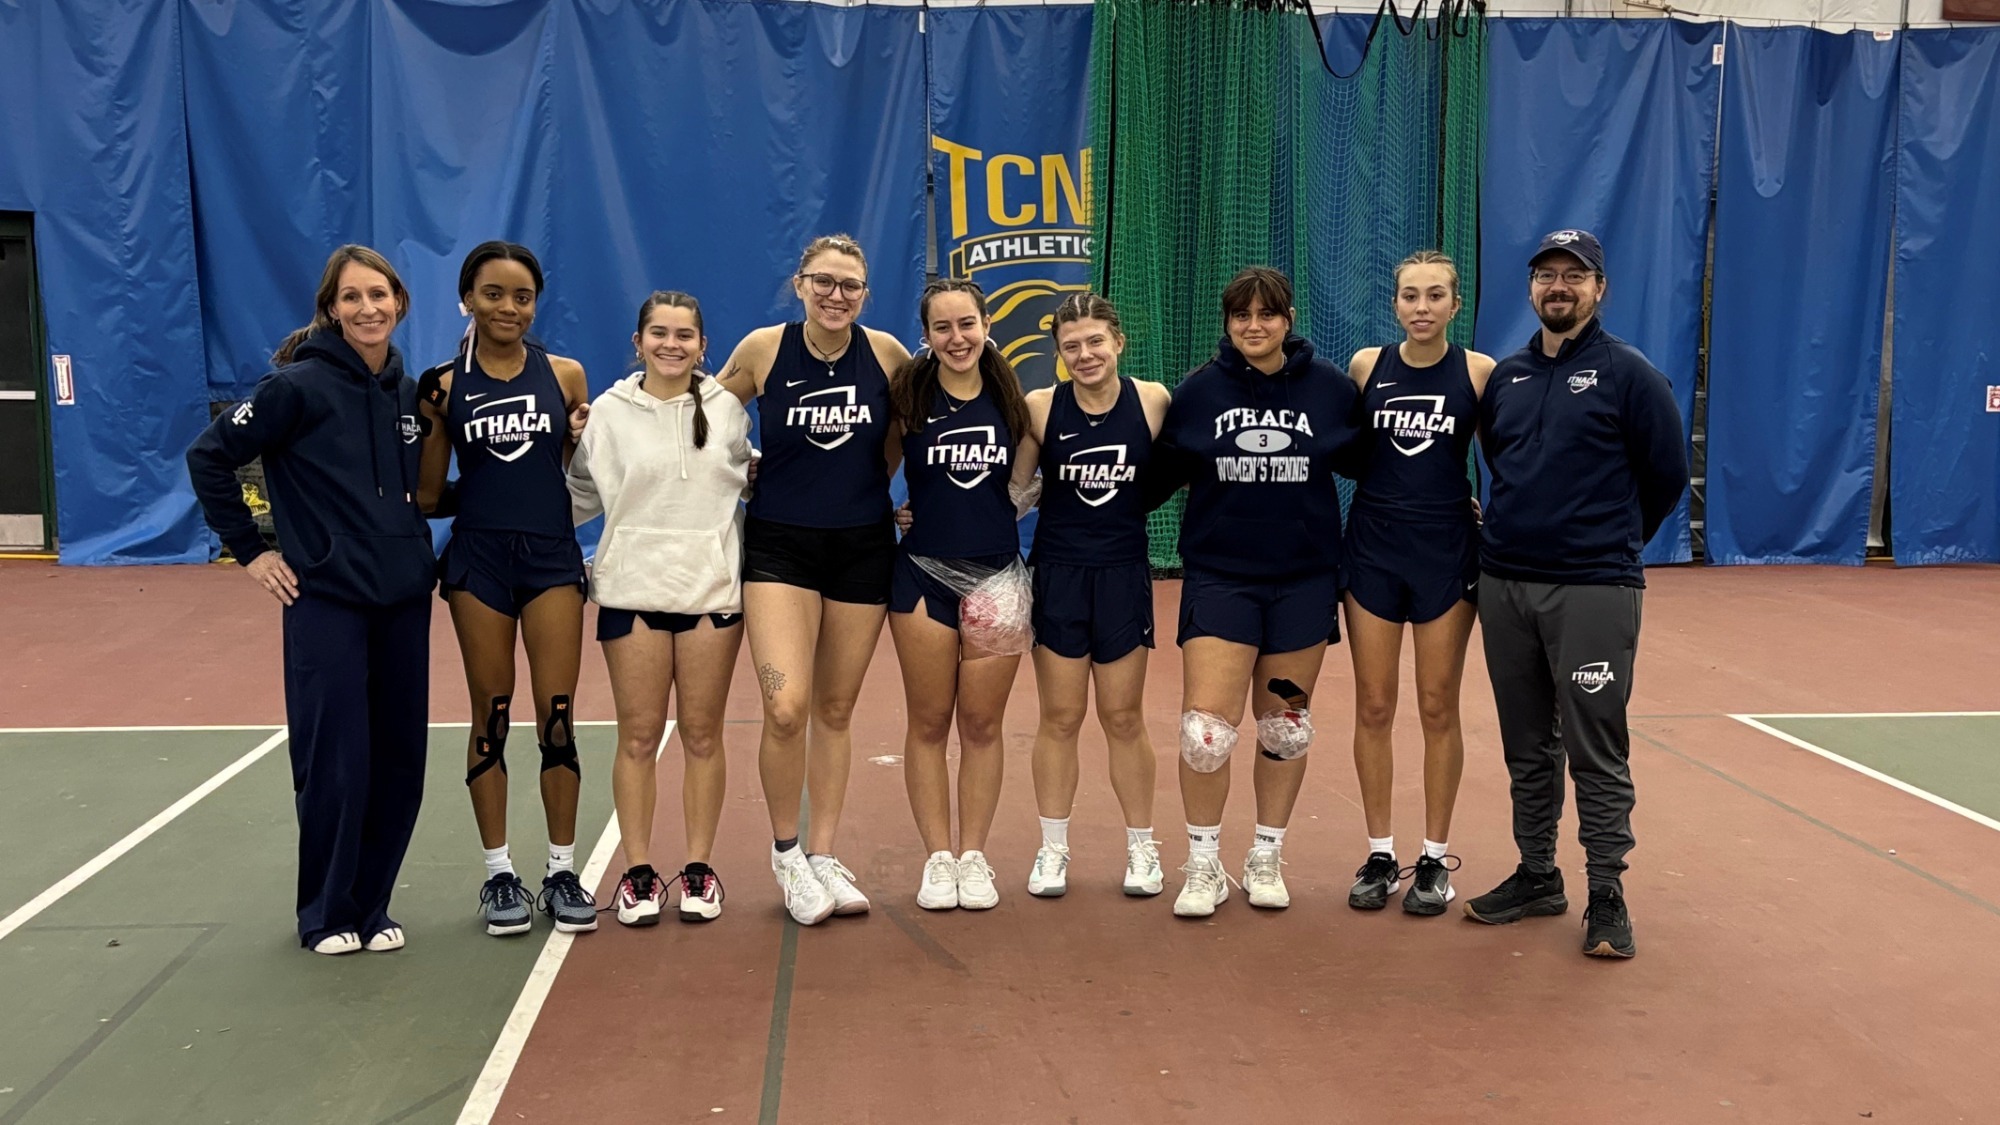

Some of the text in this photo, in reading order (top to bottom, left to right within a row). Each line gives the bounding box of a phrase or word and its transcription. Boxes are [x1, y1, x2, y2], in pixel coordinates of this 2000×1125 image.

[1567, 376, 1598, 386] ITHACA
[786, 405, 873, 426] ITHACA
[395, 421, 423, 433] IHACA
[464, 413, 552, 443] ITHACA
[810, 424, 851, 434] TENNIS
[1214, 407, 1314, 440] ITHACA
[1373, 410, 1456, 435] ITHACA
[488, 432, 530, 445] TENNIS
[1259, 433, 1268, 447] 3
[1393, 429, 1433, 439] TENNIS
[927, 444, 1007, 465] ITHACA
[950, 463, 989, 471] TENNIS
[1059, 464, 1136, 482] ITHACA
[1215, 456, 1310, 482] WOMEN'S TENNIS
[1078, 481, 1116, 489] TENNIS
[1572, 671, 1614, 681] ITHACA
